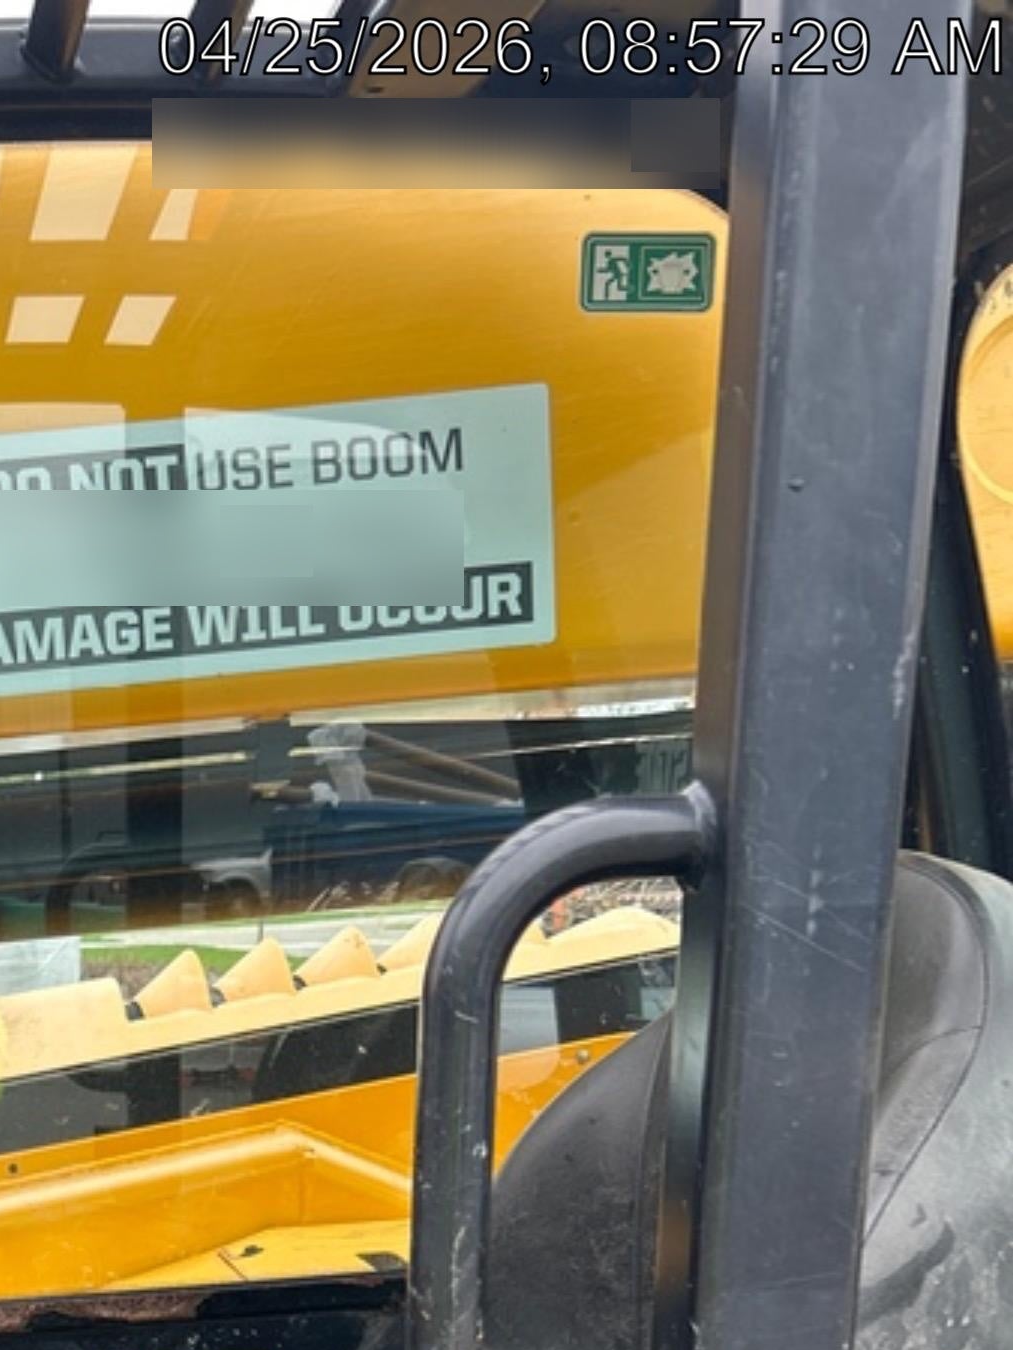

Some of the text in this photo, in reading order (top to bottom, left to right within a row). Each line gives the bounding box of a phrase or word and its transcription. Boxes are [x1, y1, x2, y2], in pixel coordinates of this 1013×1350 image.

[69, 455, 179, 490] NOT
[196, 444, 294, 490] USE
[311, 427, 464, 486] BOOM
[187, 606, 326, 647] WILL
